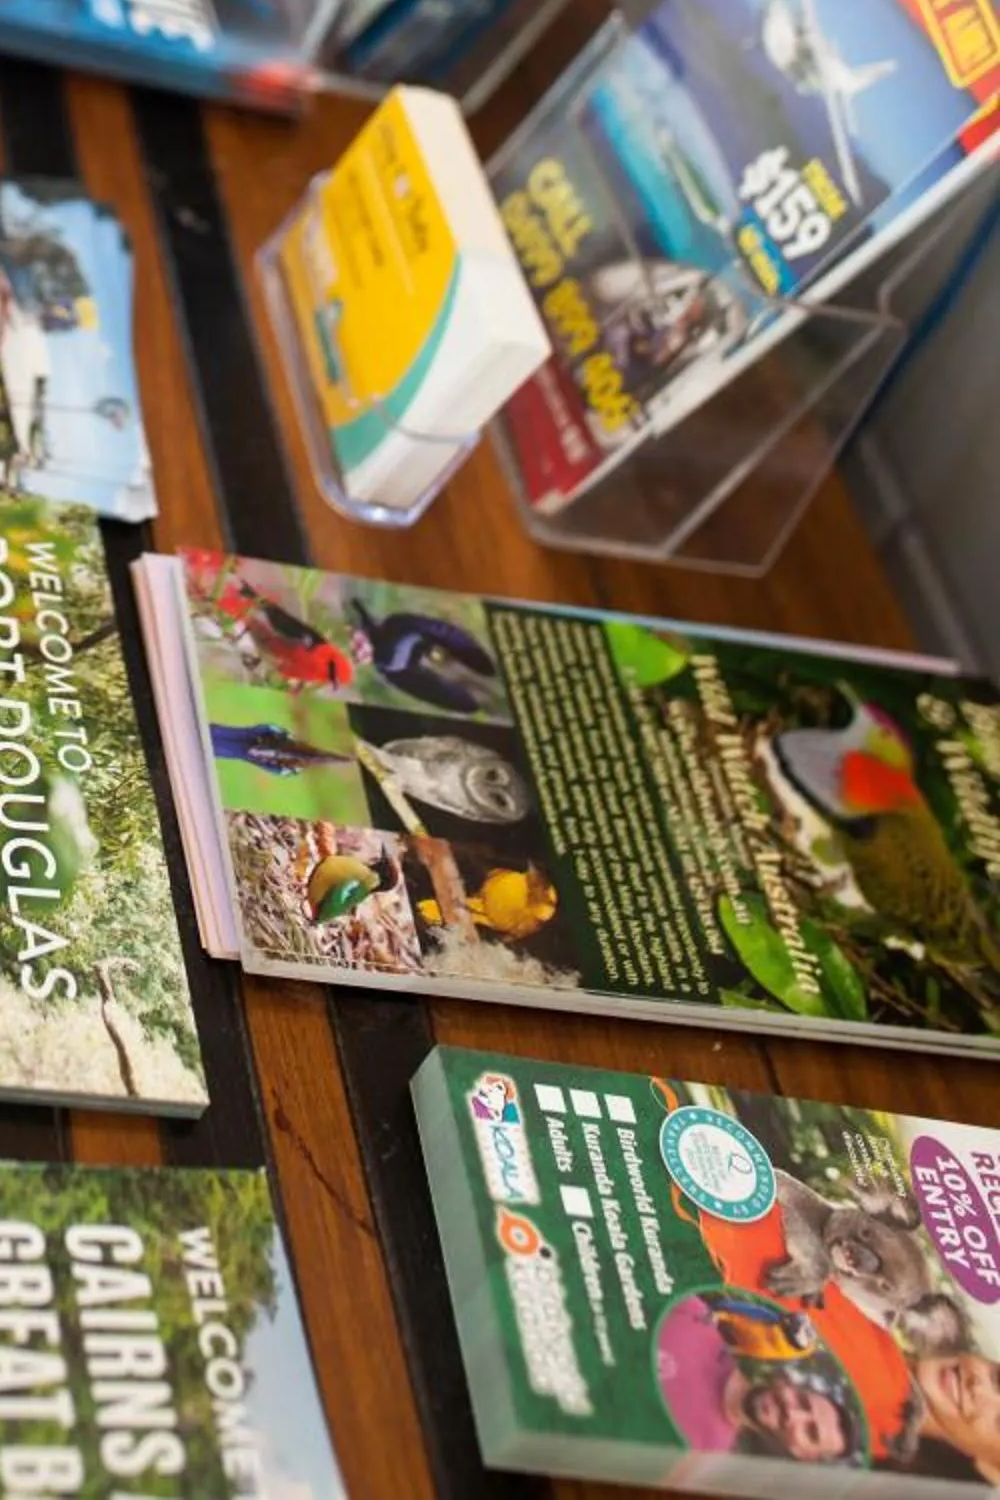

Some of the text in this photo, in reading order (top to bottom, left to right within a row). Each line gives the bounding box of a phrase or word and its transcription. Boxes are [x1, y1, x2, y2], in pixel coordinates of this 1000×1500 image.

[739, 146, 832, 261] $159
[24, 541, 93, 774] WELCOME TO
[690, 654, 737, 725] Wild
[716, 734, 768, 832] Watch
[749, 835, 822, 994] Australia
[647, 935, 674, 990] highland
[489, 1123, 525, 1201] KOALA
[546, 1116, 602, 1304] Adults Children
[582, 1122, 647, 1330] Kuranda Koala Gardens
[616, 1128, 675, 1294] Birdworld Kuranda
[914, 1165, 970, 1269] ENTRY
[935, 1155, 1000, 1287] 10% OFF
[64, 1223, 187, 1478] CAIRNS
[177, 1226, 263, 1482] WELCOME
